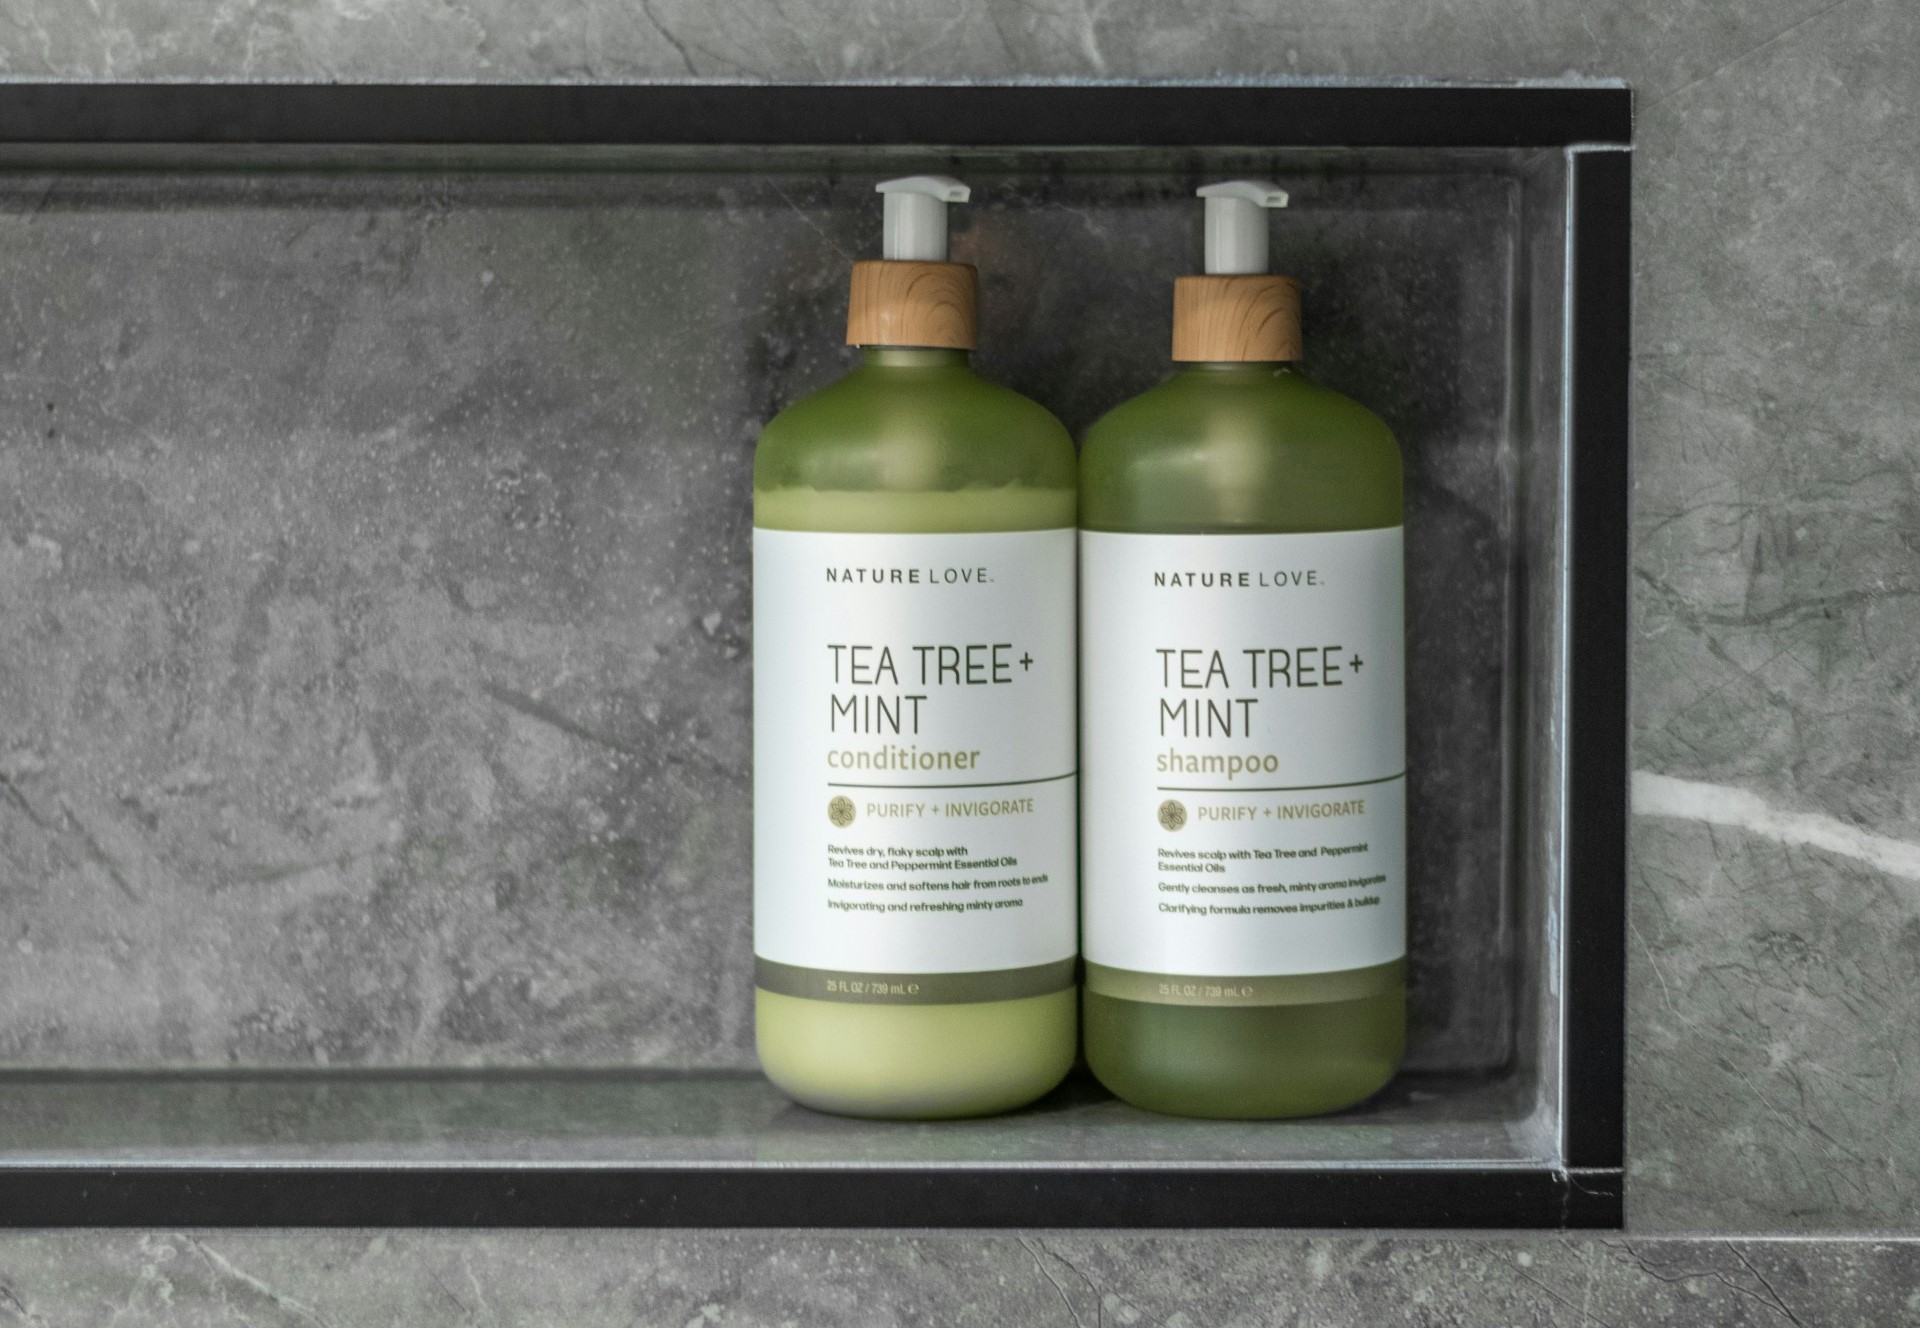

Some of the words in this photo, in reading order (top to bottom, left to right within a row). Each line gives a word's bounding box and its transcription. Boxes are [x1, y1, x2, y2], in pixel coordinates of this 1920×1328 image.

[826, 568, 920, 584] NATURE
[1154, 572, 1250, 587] NATURE
[827, 645, 898, 685] TEA
[1156, 649, 1229, 689] TEA
[831, 694, 927, 734] MINT
[1160, 698, 1258, 738] MINT
[827, 745, 980, 770] conditioner
[1156, 748, 1279, 781] shampoo
[867, 802, 925, 818] PURIFY
[945, 798, 1034, 817] INVIGORATE
[1199, 806, 1257, 820] PURIFY
[1277, 800, 1365, 820] INVIGORATE
[828, 844, 864, 856] Revives
[866, 846, 885, 858] dry,
[888, 846, 913, 858] flaky
[916, 846, 945, 858] scalp
[946, 846, 968, 856] with
[1158, 848, 1196, 859] Revives
[1199, 849, 1226, 860] scalp
[1229, 849, 1251, 860] with
[1254, 849, 1272, 859] Tea
[1274, 848, 1296, 859] Tree
[1298, 847, 1317, 858] and
[829, 858, 844, 868] Tea
[847, 859, 867, 869] Tree
[869, 860, 889, 870] and
[891, 861, 952, 872] Peppermint
[955, 858, 999, 869] Essential
[1001, 857, 1017, 867] Oils
[1158, 862, 1203, 873] Essential
[1205, 863, 1225, 873] Oils
[828, 878, 884, 890] Moisturizes
[887, 881, 907, 891] and
[909, 880, 949, 891] softens
[952, 879, 971, 890] hair
[973, 878, 997, 889] from
[998, 877, 1021, 887] roots
[1022, 876, 1031, 885] to
[1031, 874, 1048, 884] ends
[1158, 882, 1190, 894] Gently
[1192, 883, 1239, 894] cleanses
[1242, 885, 1255, 894] as
[1257, 883, 1288, 894] fresh,
[1289, 882, 1317, 893] minty
[1318, 880, 1347, 890] aroma
[828, 899, 885, 913] Invigorating
[888, 902, 907, 912] and
[910, 901, 964, 913] refreshing
[966, 900, 992, 911] minty
[995, 898, 1023, 909] aroma
[1159, 903, 1207, 916] Clarifying
[1209, 904, 1251, 914] formula
[1253, 904, 1298, 914] removes
[1300, 900, 1345, 913] impurities
[871, 983, 889, 994] 739
